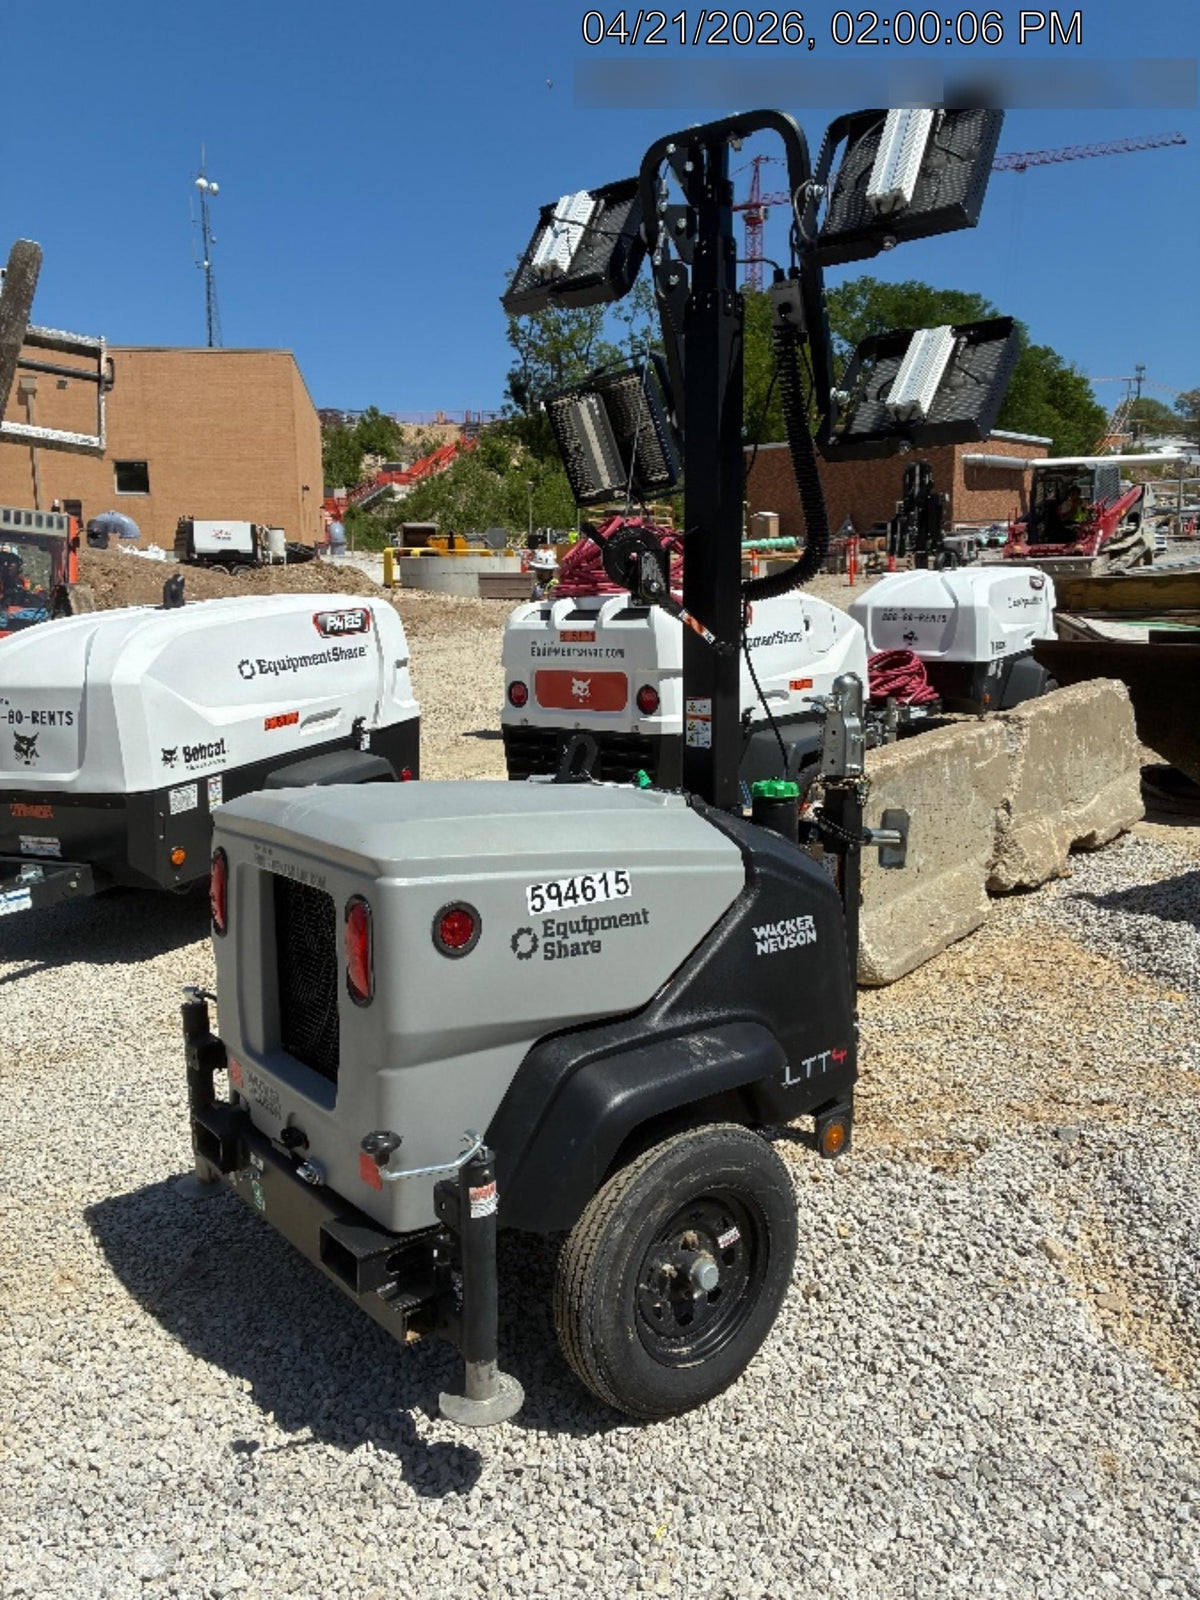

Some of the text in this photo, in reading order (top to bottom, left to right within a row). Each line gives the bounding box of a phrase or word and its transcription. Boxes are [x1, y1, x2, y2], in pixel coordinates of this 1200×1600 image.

[257, 645, 367, 677] EquipmentShare
[0, 708, 74, 727] -80-RENTS
[182, 737, 227, 764] Bobcat
[530, 870, 630, 912] 594615
[541, 907, 650, 940] Equipment
[752, 914, 815, 940] WACKER
[543, 939, 602, 961] Share
[755, 928, 817, 956] NEUSON
